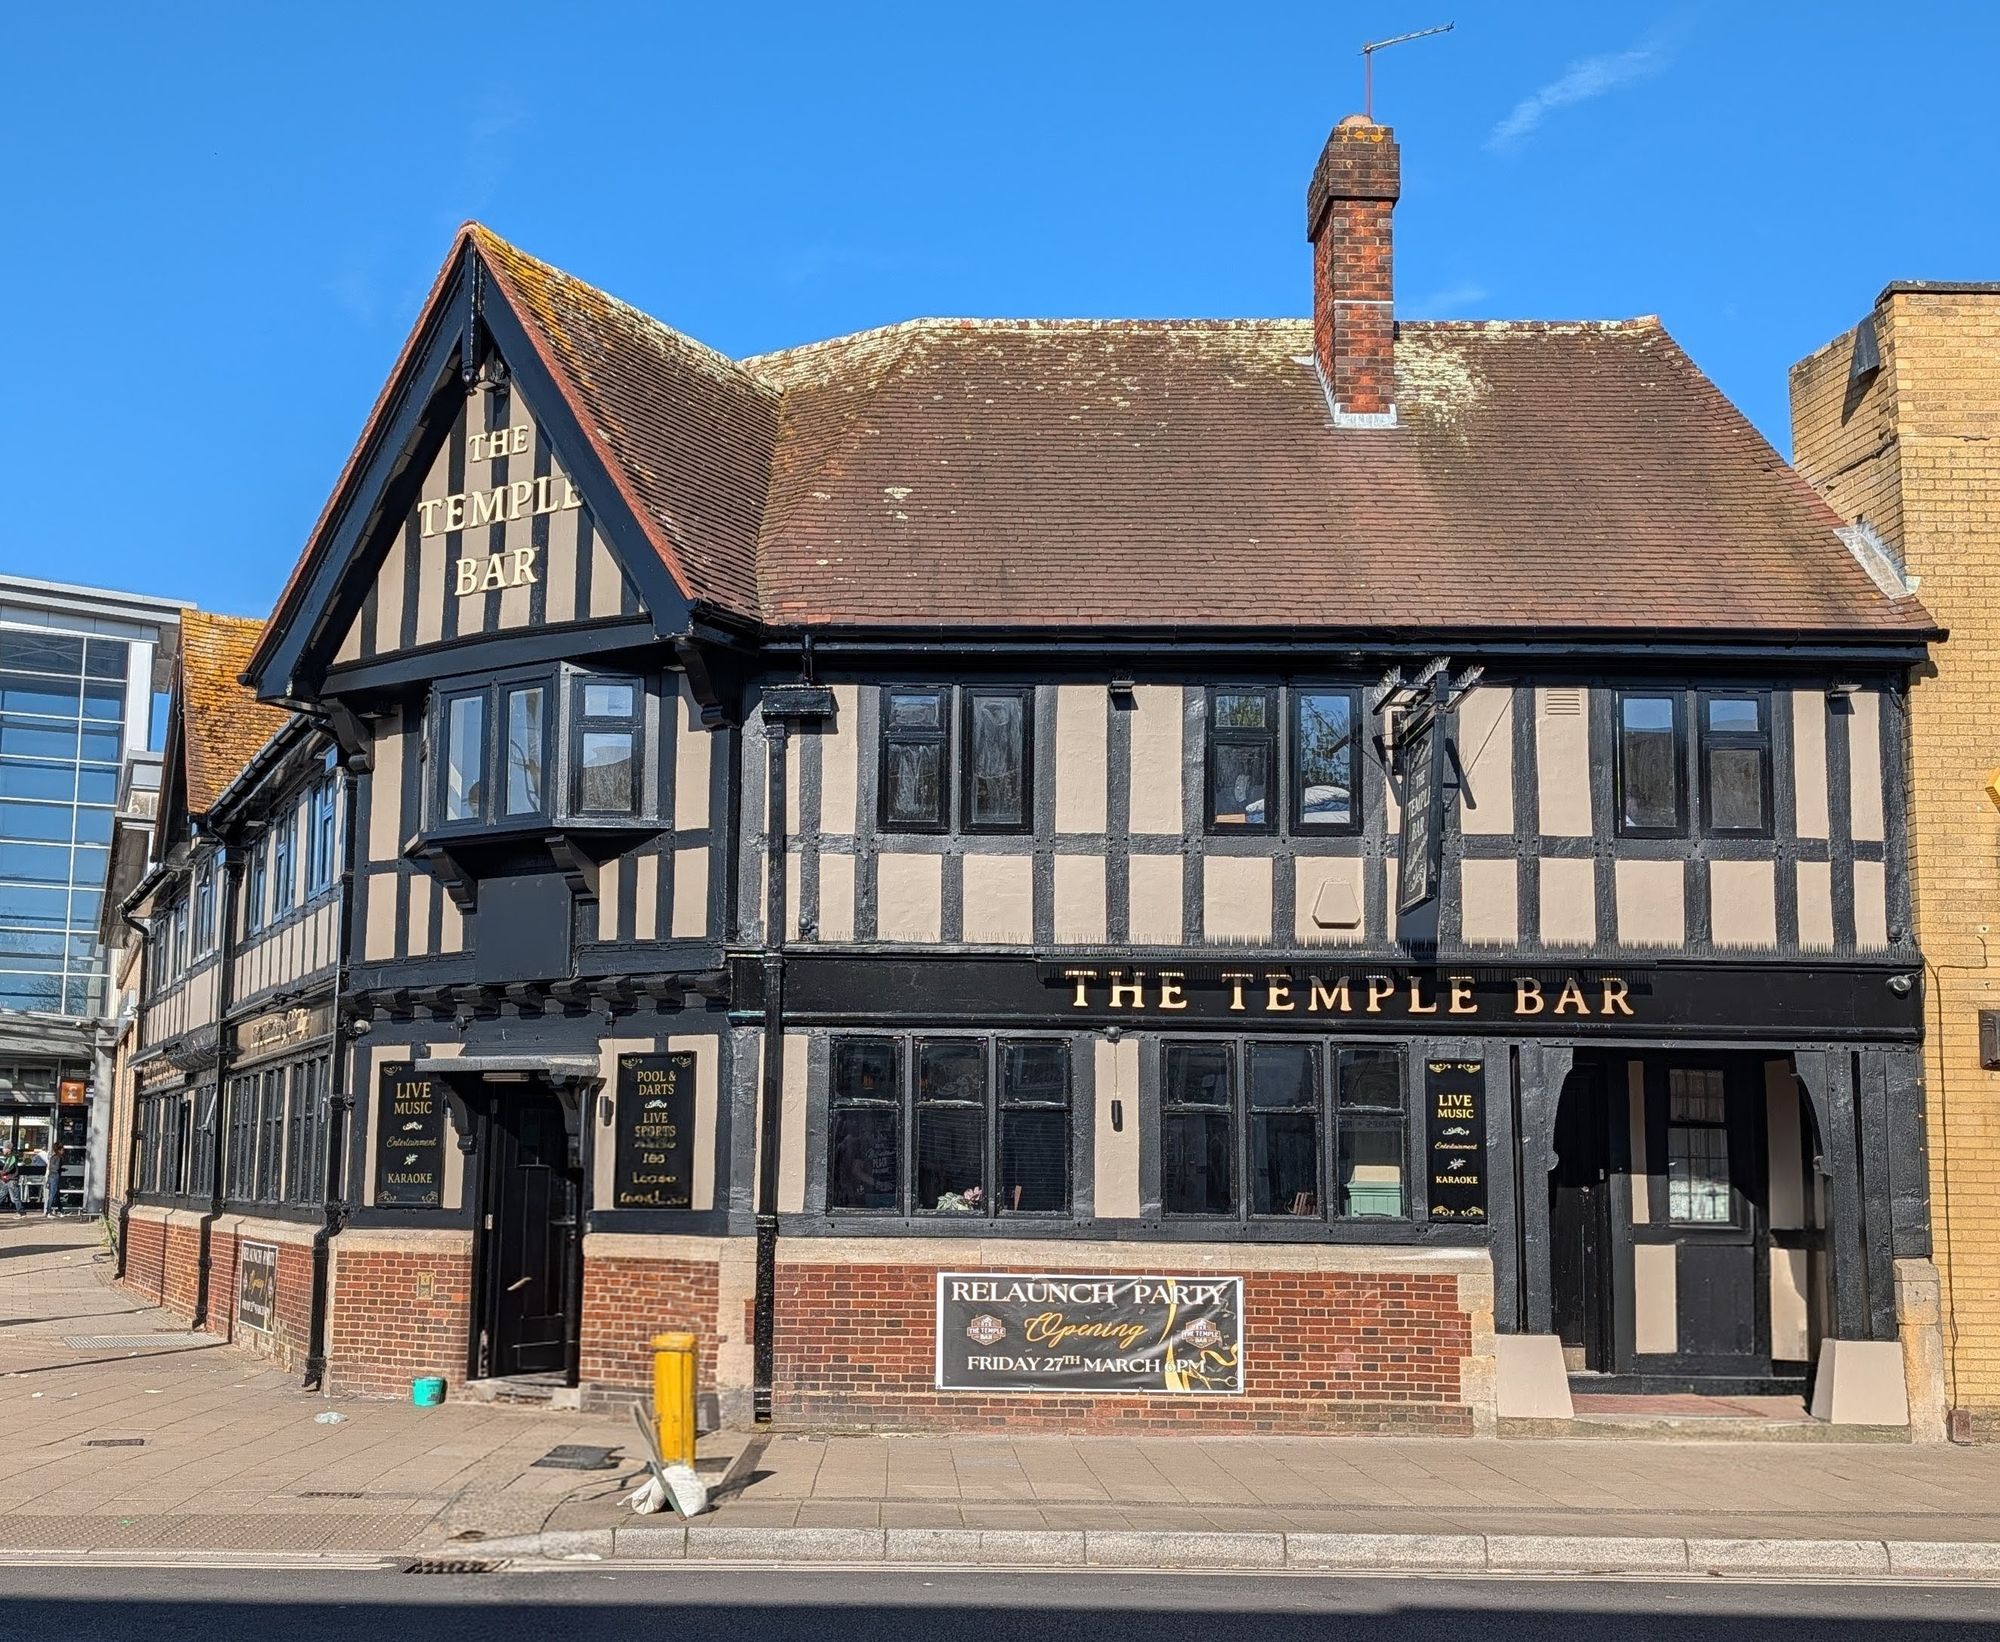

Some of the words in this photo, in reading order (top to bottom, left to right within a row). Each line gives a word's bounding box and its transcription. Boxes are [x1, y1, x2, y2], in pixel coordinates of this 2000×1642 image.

[469, 425, 529, 463] THE
[454, 547, 539, 596] BAR
[1407, 785, 1431, 820] TEMPL
[1065, 970, 1187, 1009] THE
[1221, 973, 1478, 1014] TEMPLE
[1513, 976, 1634, 1015] BAR
[637, 1071, 666, 1083] POOL
[668, 1070, 677, 1082] &
[396, 1082, 431, 1099] LIVE
[639, 1084, 674, 1096] DARTS
[1438, 1094, 1473, 1107] LIVE
[394, 1101, 433, 1115] MUSIC
[1437, 1109, 1474, 1119] MUSIC
[643, 1112, 668, 1124] LIVE
[634, 1126, 676, 1138] SPORTS
[386, 1136, 437, 1149] Entertainment
[1434, 1142, 1478, 1151] Entertainment
[388, 1173, 433, 1184] KARAOKE
[1435, 1175, 1478, 1184] KARAOKE
[952, 1281, 1114, 1304] RELAUNCH
[1134, 1284, 1227, 1305] PARTY
[1024, 1312, 1149, 1349] Opening
[967, 1356, 1040, 1372] FRIDAY
[1044, 1355, 1081, 1372] 27TH
[1083, 1358, 1161, 1373] MARCH
